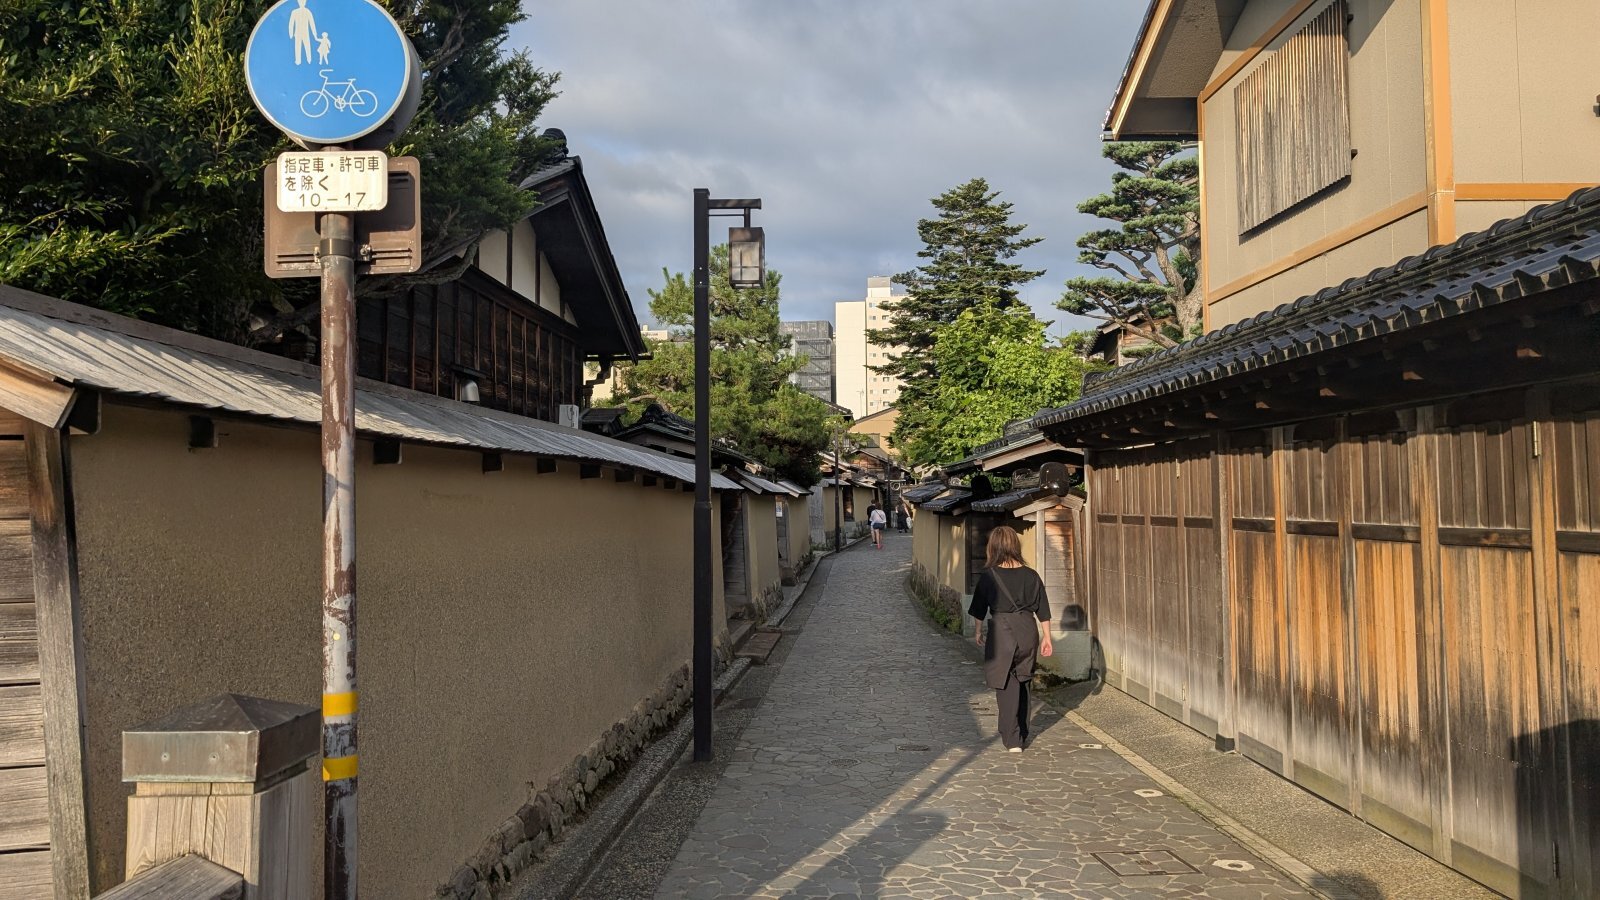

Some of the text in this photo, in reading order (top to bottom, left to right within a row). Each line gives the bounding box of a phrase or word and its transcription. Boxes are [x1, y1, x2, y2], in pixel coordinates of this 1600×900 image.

[284, 156, 380, 173] 指定車・許可車
[284, 175, 329, 191] を除く
